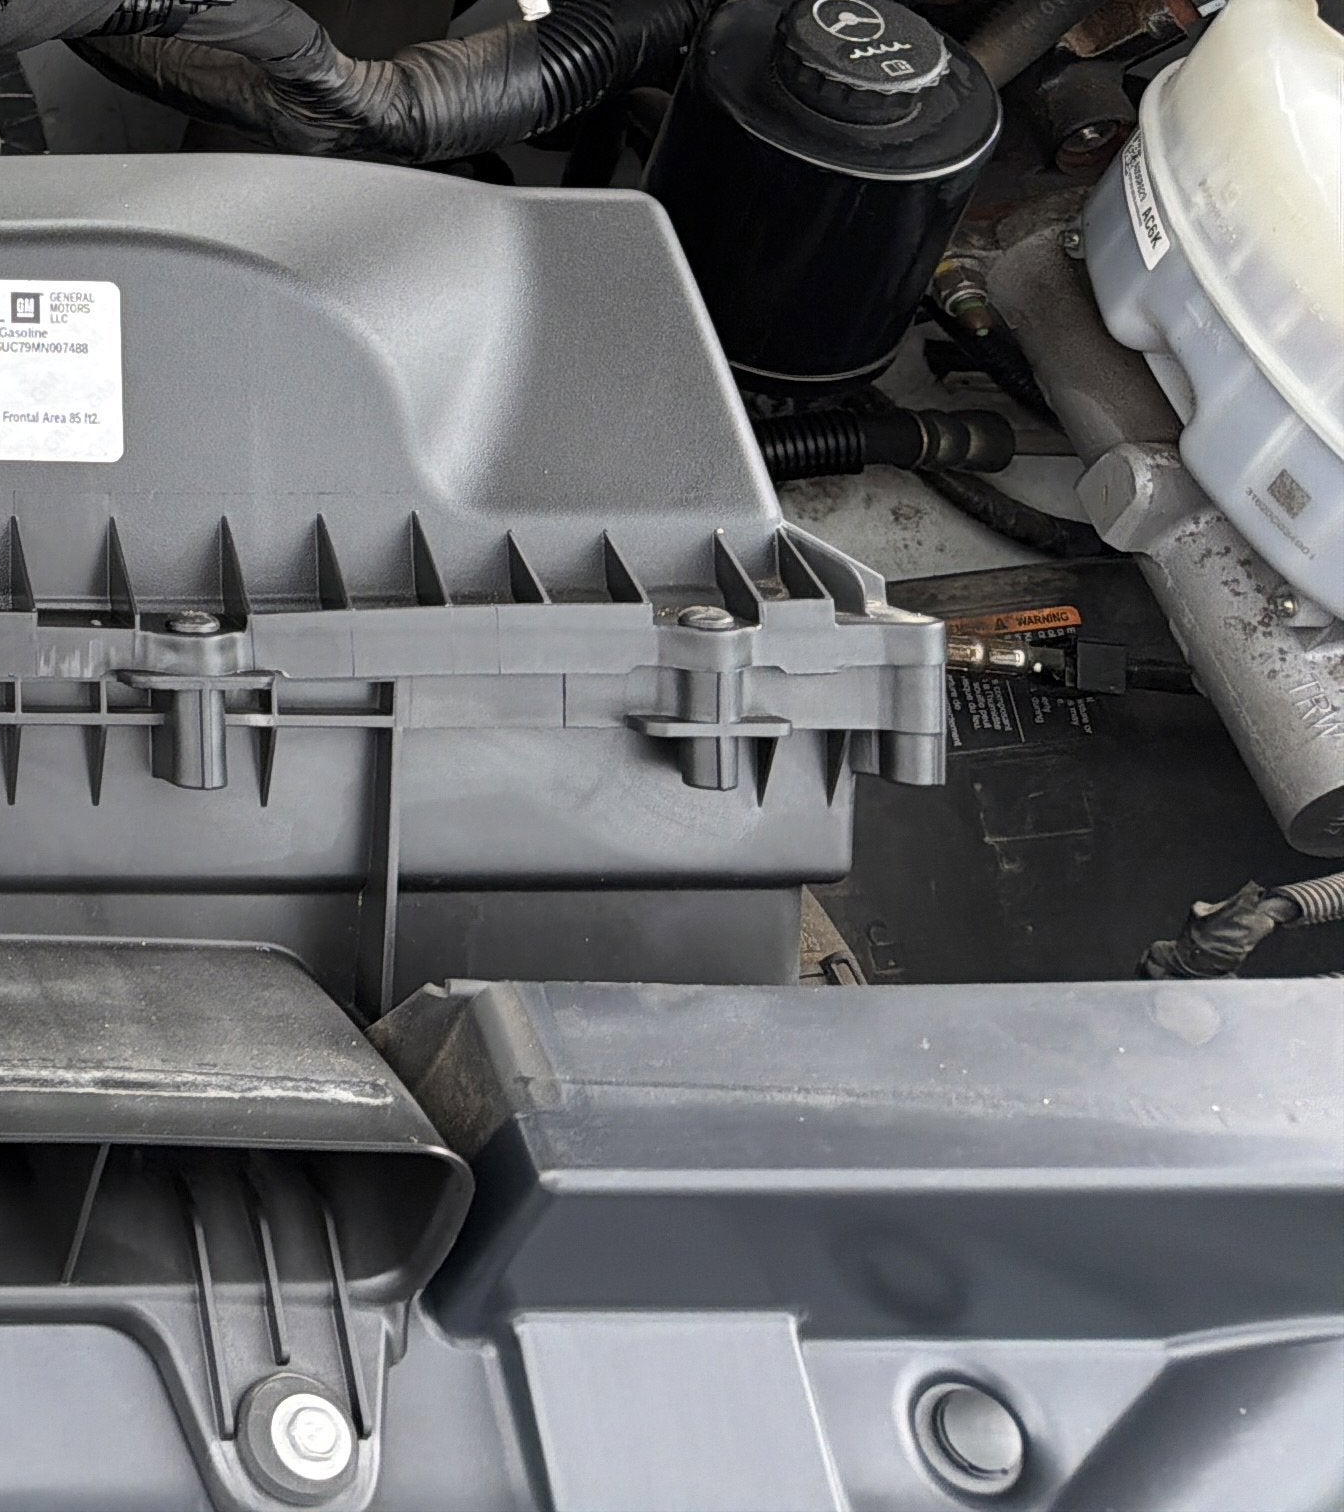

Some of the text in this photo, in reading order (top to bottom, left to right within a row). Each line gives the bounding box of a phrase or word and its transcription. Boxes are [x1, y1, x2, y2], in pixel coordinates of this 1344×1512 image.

[49, 292, 95, 303] GENERAL
[49, 303, 91, 314] MOTORS
[50, 314, 68, 324] LLC
[3, 411, 39, 423] Frontal
[42, 412, 67, 423] Area
[69, 412, 81, 424] 85
[1016, 611, 1070, 627] WARNING
[1288, 672, 1344, 739] TRW
